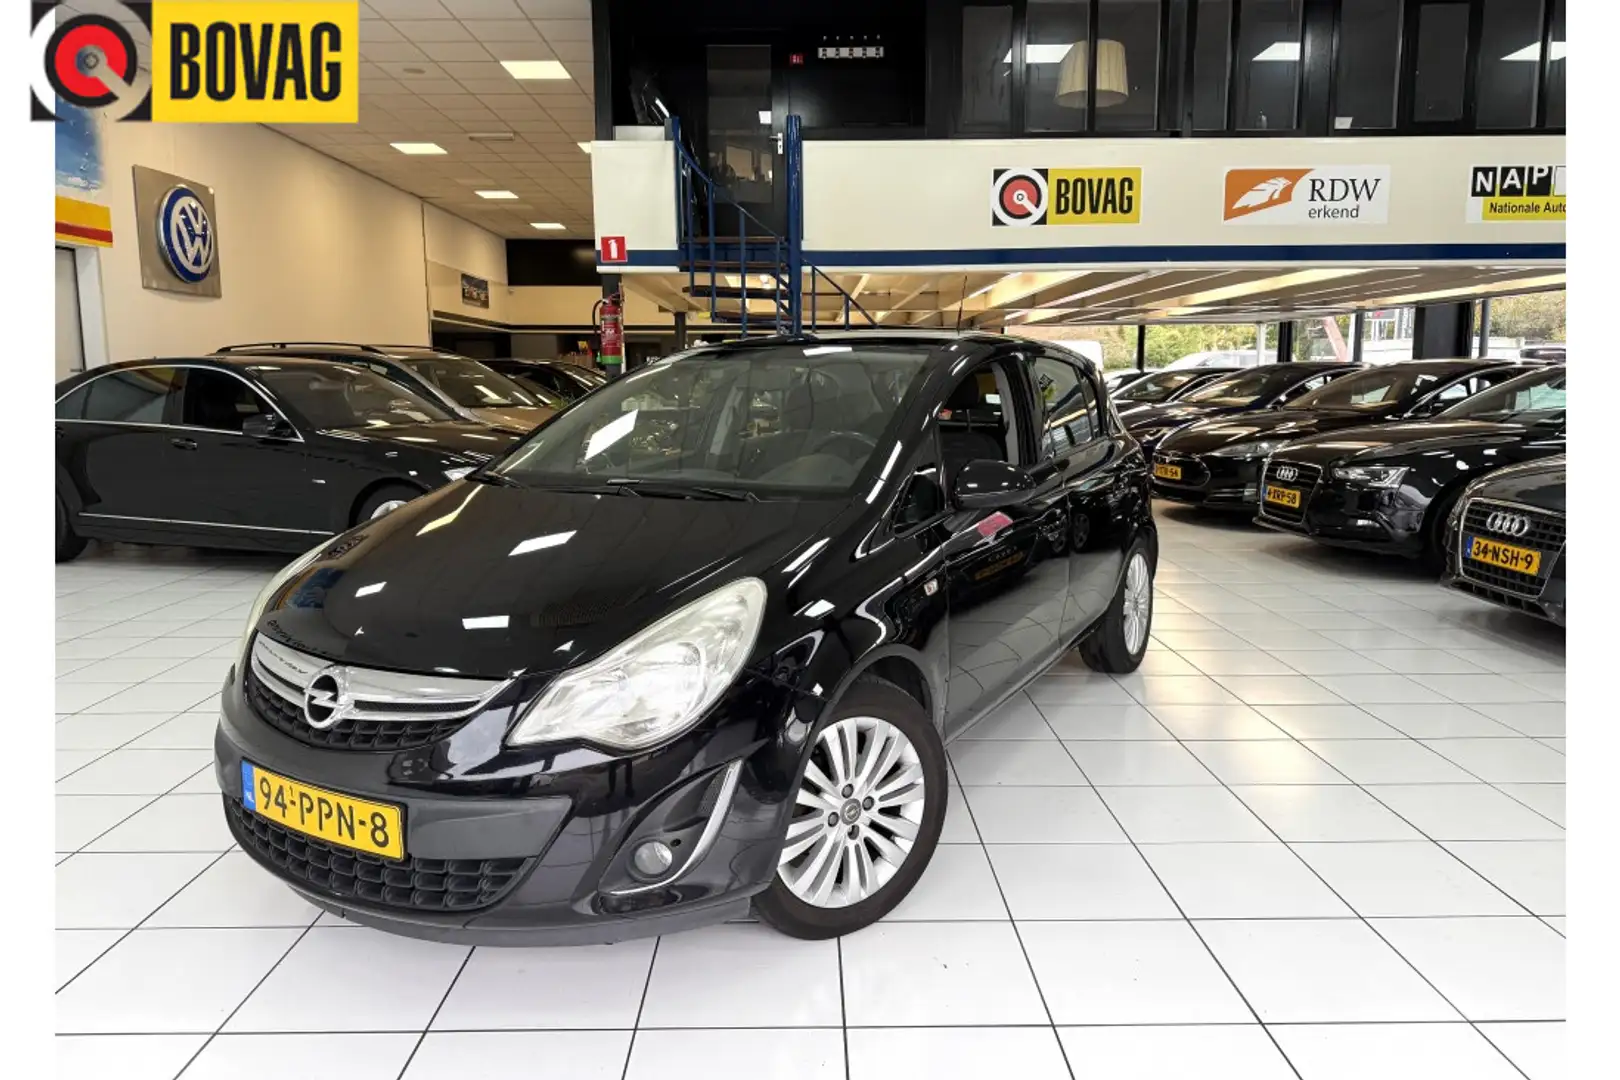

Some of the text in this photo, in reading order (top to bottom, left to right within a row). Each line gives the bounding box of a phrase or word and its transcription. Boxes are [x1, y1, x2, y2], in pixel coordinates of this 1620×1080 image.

[1308, 178, 1382, 202] RDW
[1475, 166, 1549, 192] NAP
[1055, 177, 1134, 215] BOVAG
[1488, 201, 1541, 213] Nationale
[1308, 204, 1360, 219] erkend
[1473, 541, 1534, 570] 34-NSH-9
